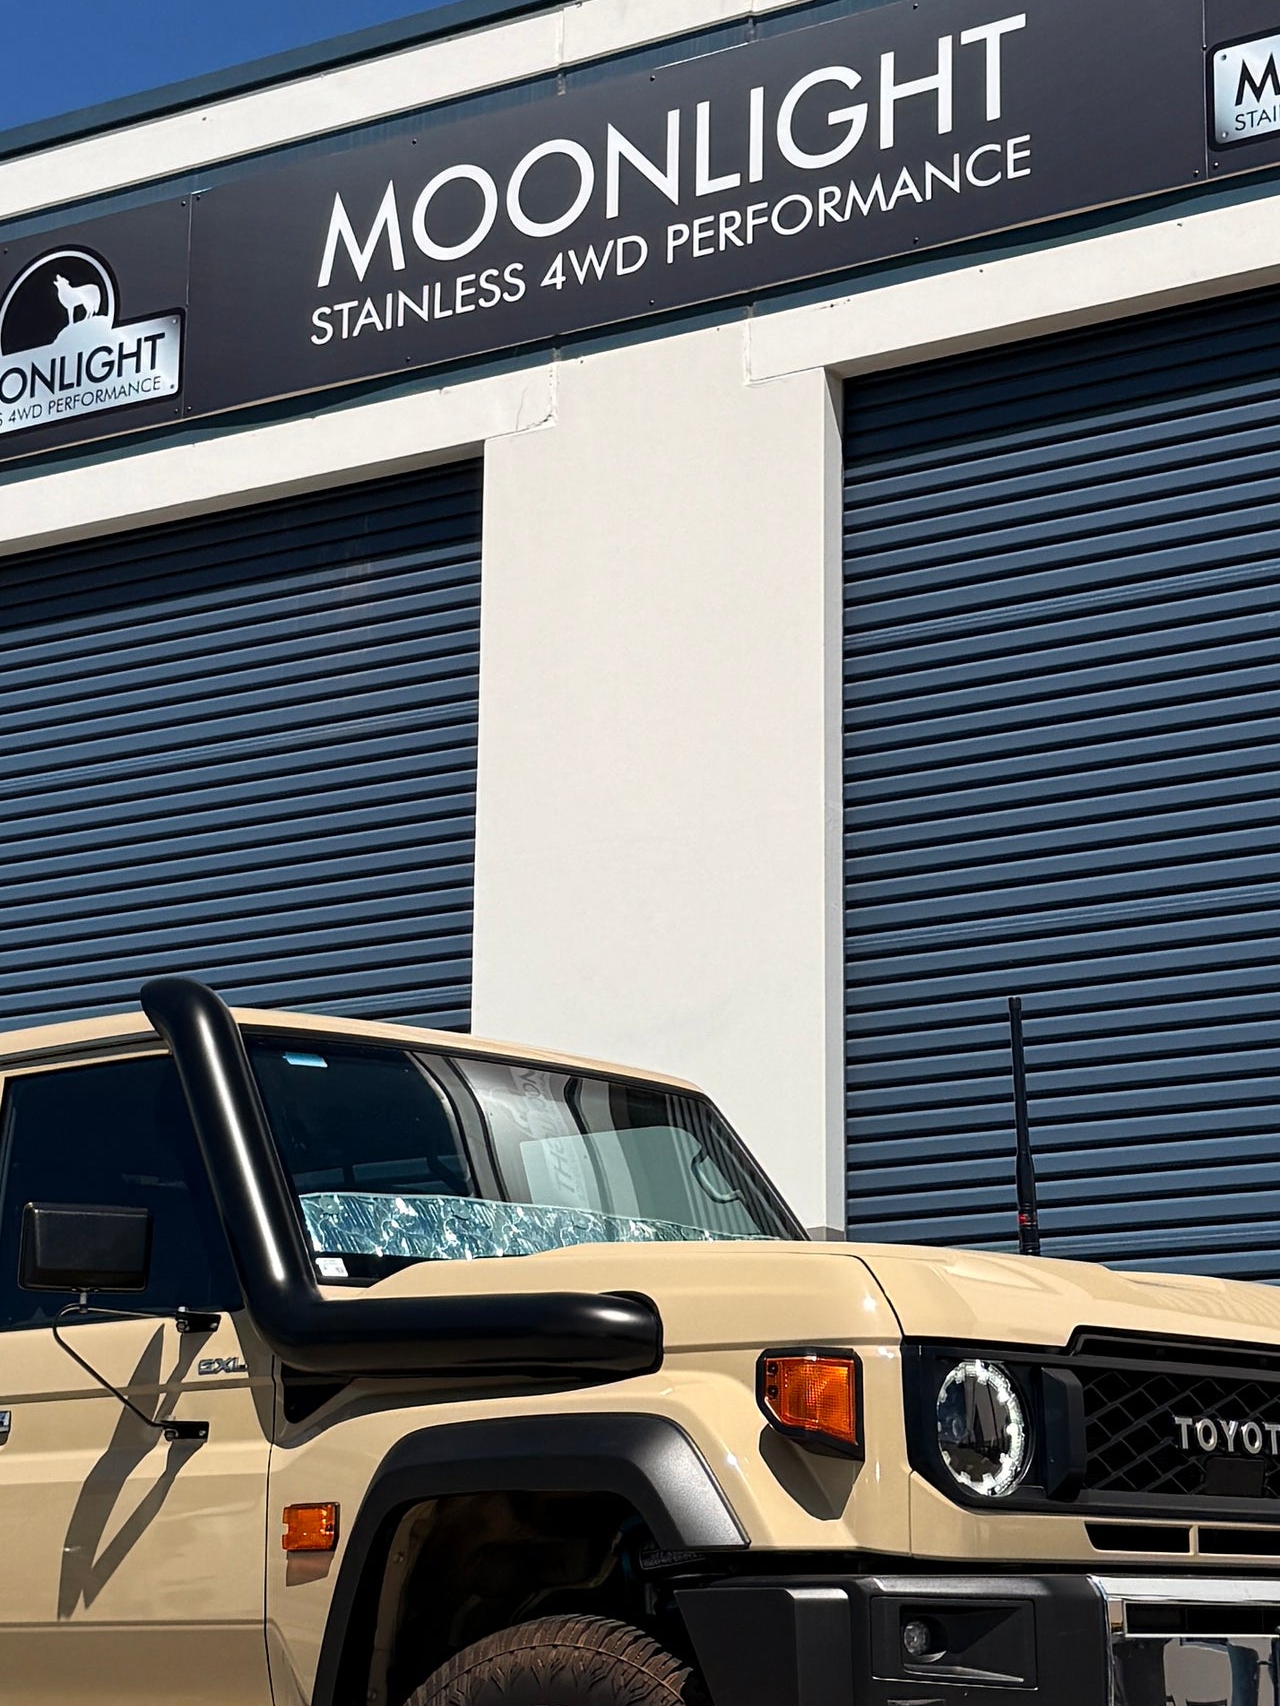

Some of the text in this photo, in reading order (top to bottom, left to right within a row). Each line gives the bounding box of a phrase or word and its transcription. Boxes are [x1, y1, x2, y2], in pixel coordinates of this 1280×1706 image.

[310, 134, 1031, 345] STAINLESS 4WD PERFORMANCE
[318, 13, 1027, 288] MOONLIGHT
[8, 404, 43, 423] 4WD
[48, 376, 161, 415] PERFORMANCE
